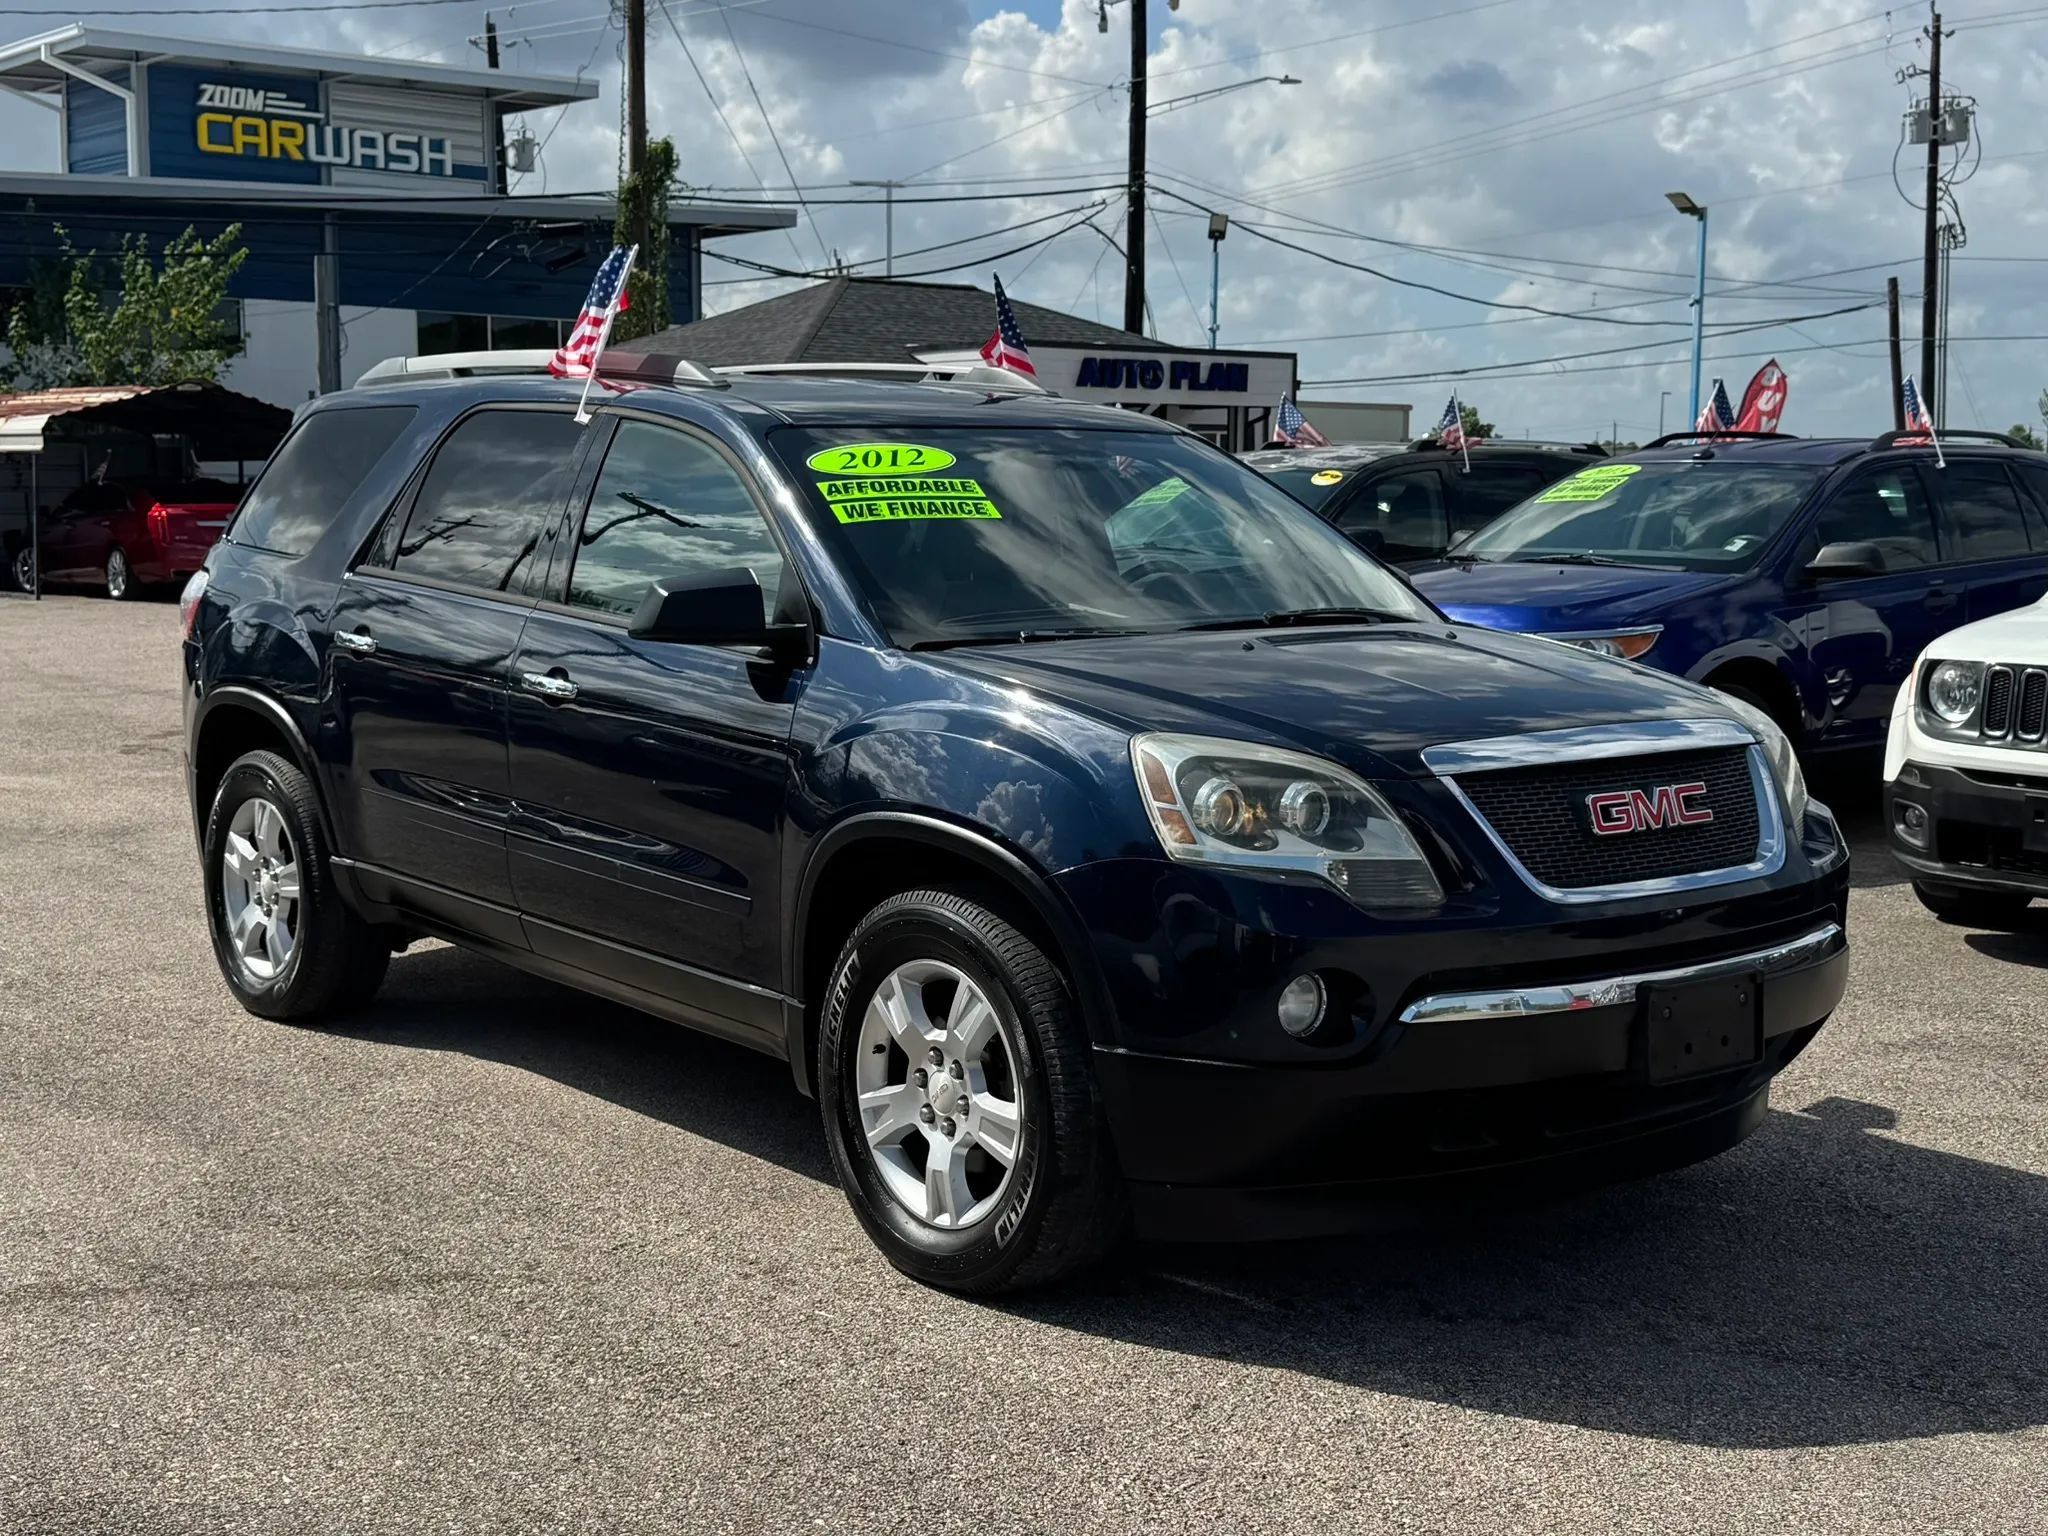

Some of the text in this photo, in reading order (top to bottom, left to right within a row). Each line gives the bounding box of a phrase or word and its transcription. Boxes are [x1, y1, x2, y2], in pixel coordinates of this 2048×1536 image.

[197, 83, 266, 113] ZOOM
[1076, 357, 1249, 392] AUTO PLAN
[839, 448, 926, 471] 2012
[821, 479, 979, 498] AFFORDABLE
[842, 501, 991, 520] WE FINANCE
[1585, 781, 1714, 836] GMC
[824, 953, 860, 1062] ICHELIN
